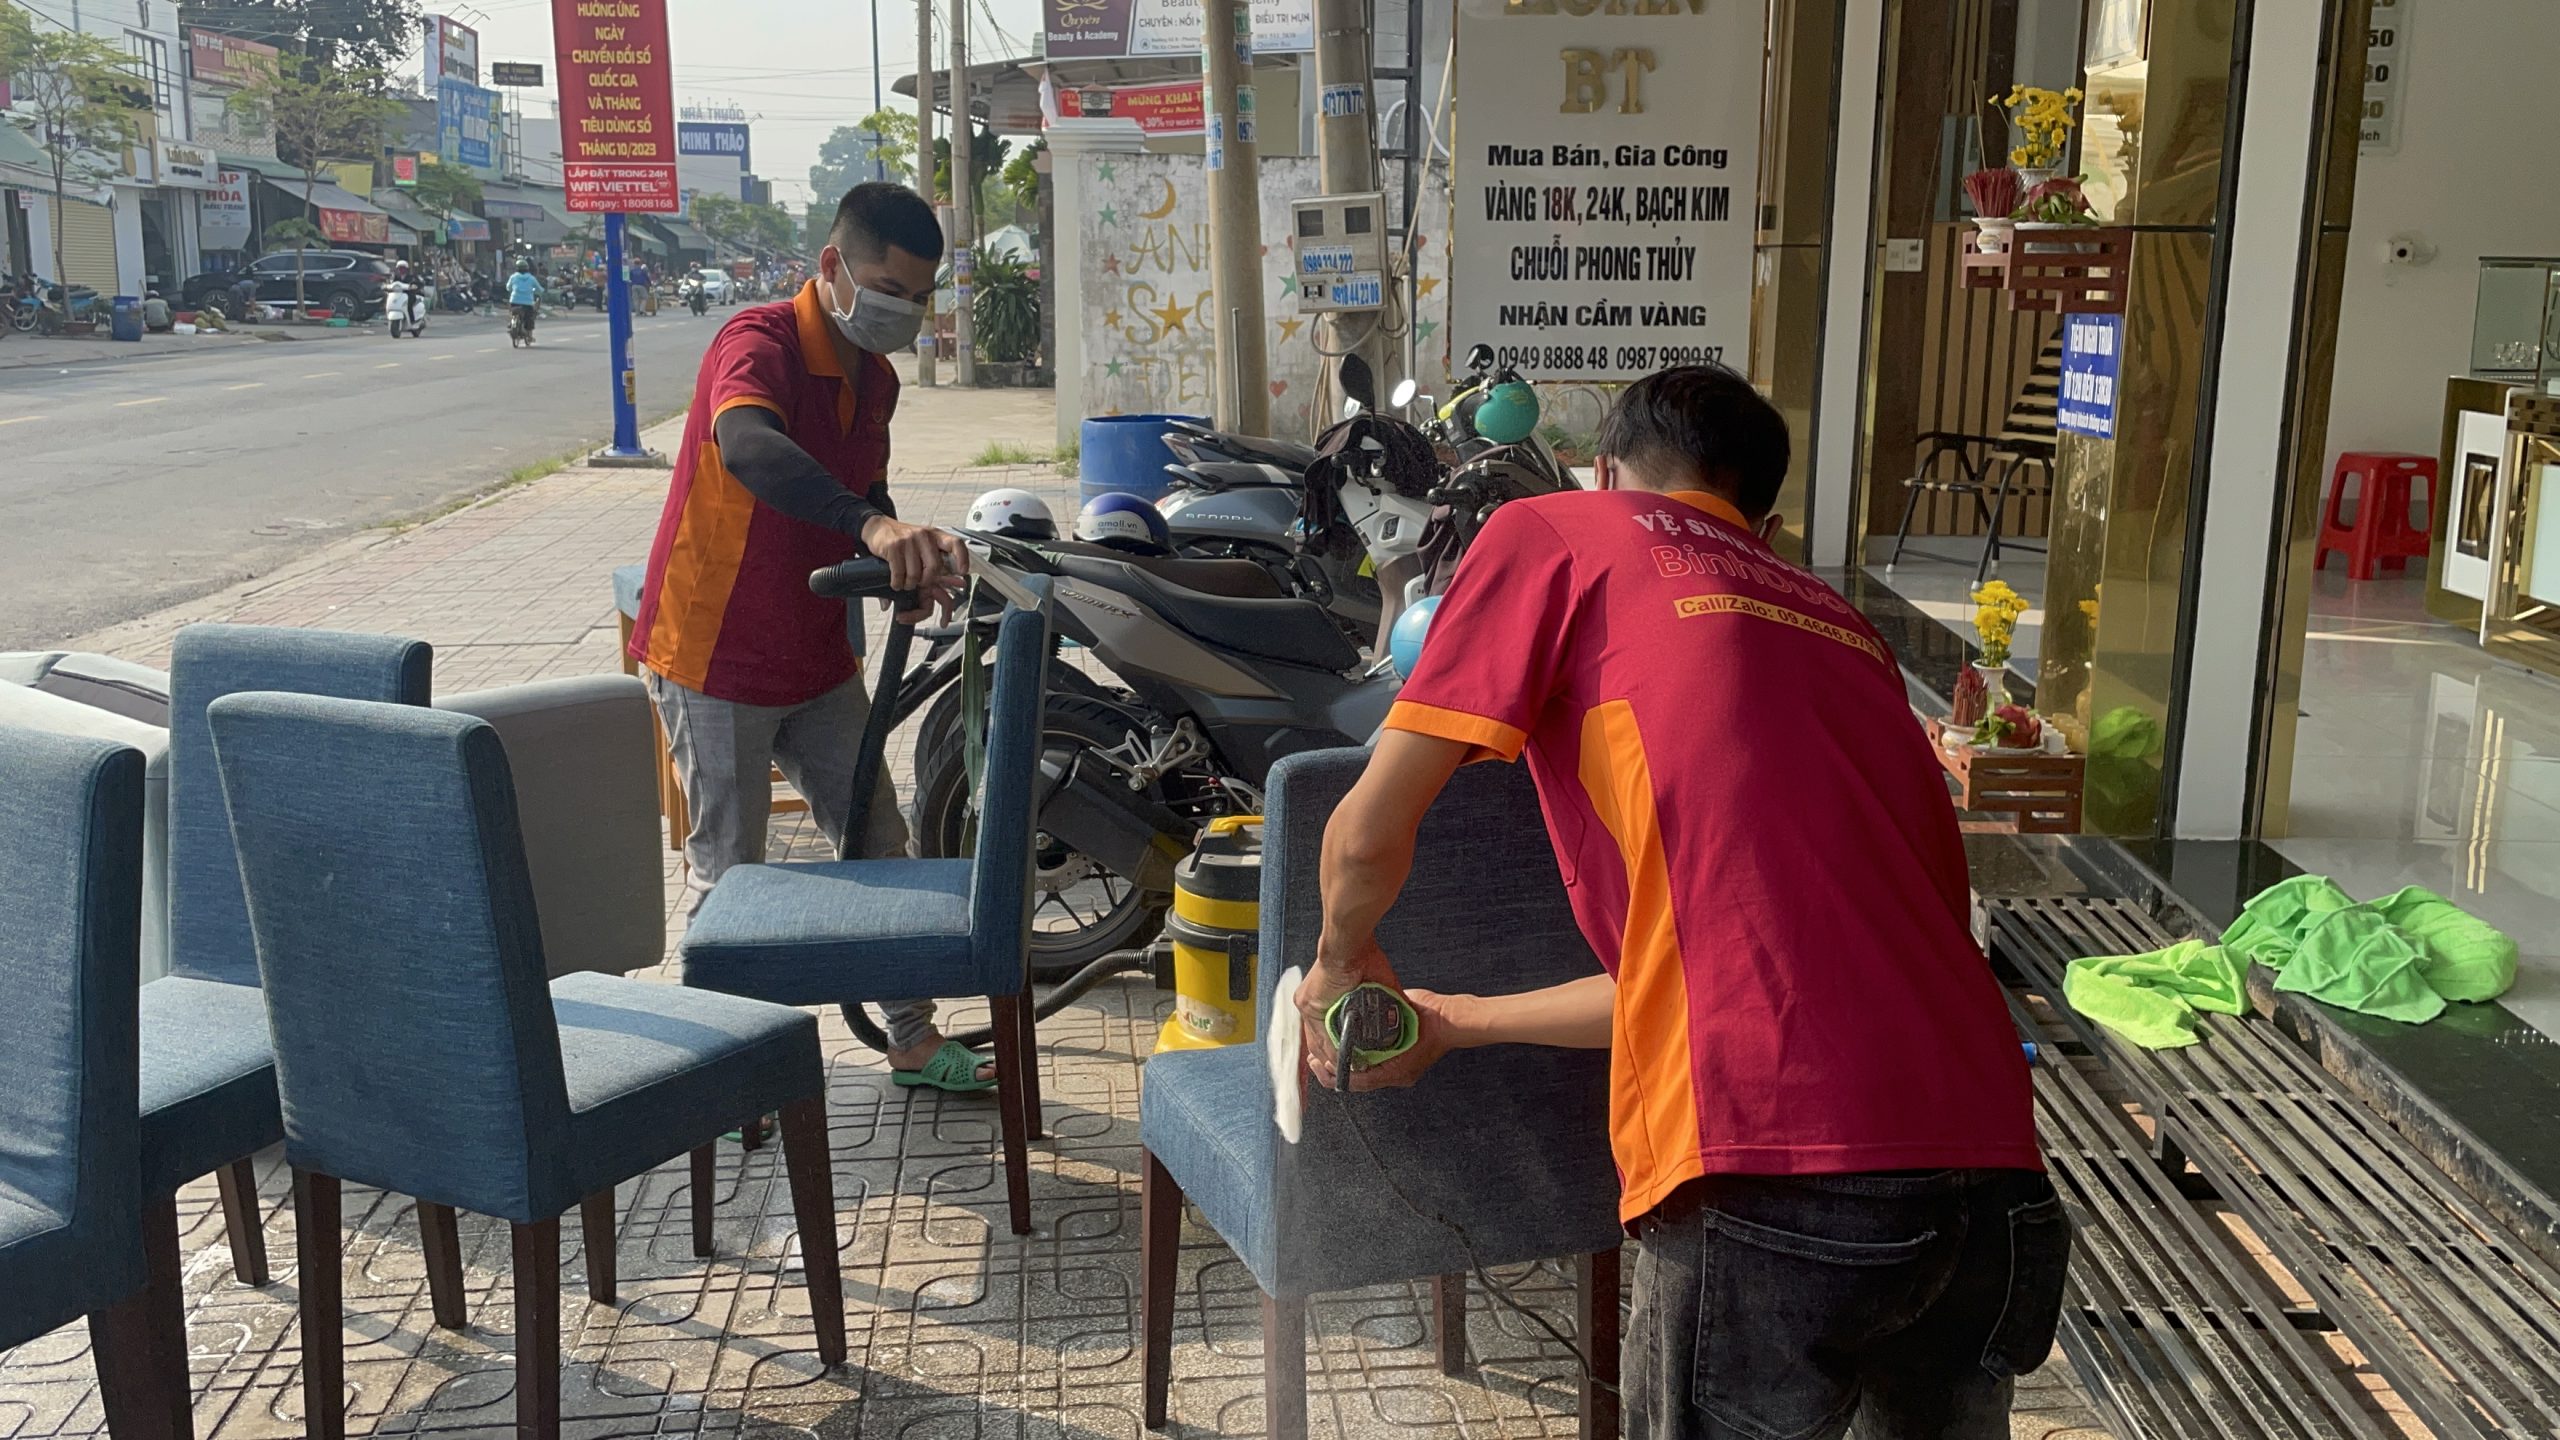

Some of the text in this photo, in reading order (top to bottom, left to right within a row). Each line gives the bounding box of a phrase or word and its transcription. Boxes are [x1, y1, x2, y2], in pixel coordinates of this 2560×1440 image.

[1138, 14, 1173, 28] CHUYÊN
[595, 23, 625, 40] NGÀY
[1047, 31, 1118, 42] Beauty & Academy
[571, 43, 651, 64] CHUYỂN ĐỔI SỐ
[589, 67, 638, 87] QUỐC GIA
[1559, 47, 1657, 114] BT
[588, 92, 641, 110] VÀ THÁNG
[1165, 91, 1192, 104] KHAI
[580, 113, 652, 133] TIÊU DÙNG SỐ
[579, 138, 657, 158] THÁNG 10/2023
[681, 127, 745, 151] MINH THẢO
[1488, 143, 1728, 169] Mua Bán, Gia Công
[568, 167, 667, 179] LẮP ĐẶT TRONG 24H
[570, 181, 600, 192] WIFI
[602, 181, 658, 192] VIETTEL
[570, 198, 673, 211] Gọi ngay: 18008168
[1485, 180, 1730, 228] VÀNG 18K, 24K, BẠCH KIM
[1511, 234, 1696, 281] CHUỖI PHONG THỦY
[1500, 298, 1707, 331] NHẬN CẦM VÀNG
[1499, 345, 1540, 370] 0949
[1543, 345, 1585, 370] 8888
[1587, 345, 1608, 370] 48
[1616, 346, 1657, 370] 0987
[1098, 520, 1138, 529] amall.vn
[1632, 509, 1753, 556] VỆ SINH
[1680, 597, 1774, 619] Call/Zalo:
